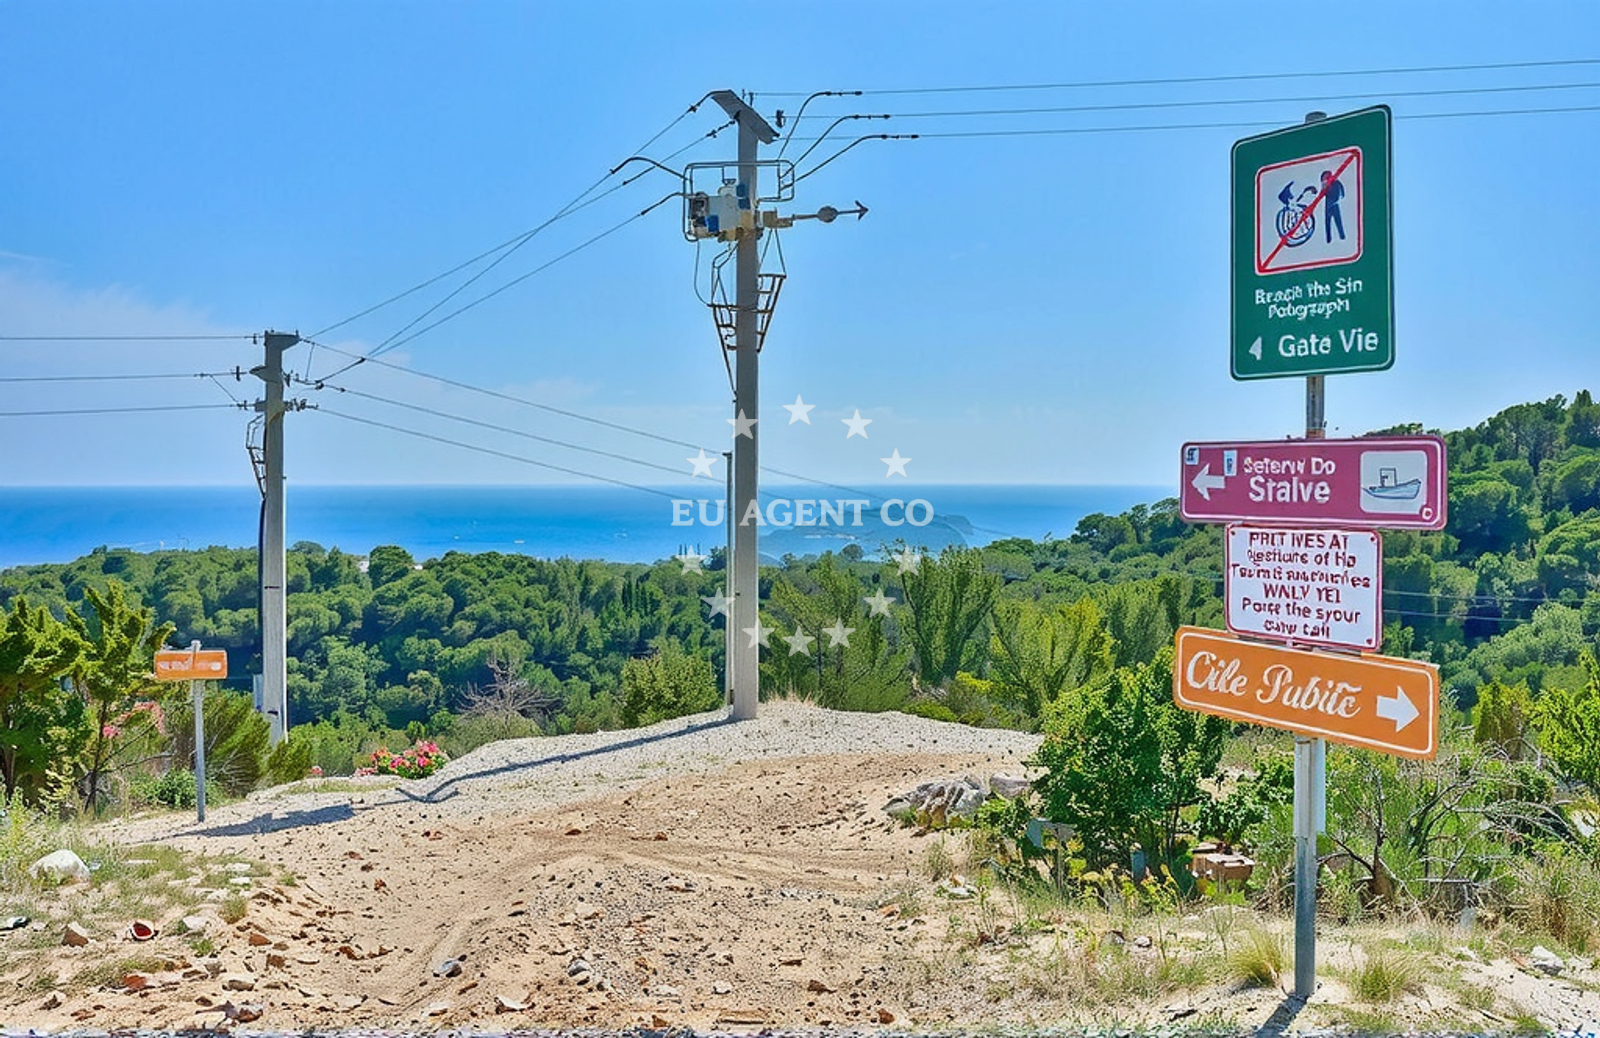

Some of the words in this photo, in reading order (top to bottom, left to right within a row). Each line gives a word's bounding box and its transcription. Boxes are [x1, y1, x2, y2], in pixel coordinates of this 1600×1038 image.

[1278, 333, 1332, 358] Gate
[1338, 327, 1379, 353] Vie
[1311, 456, 1336, 475] Do
[1314, 551, 1330, 566] of
[1286, 602, 1312, 618] the
